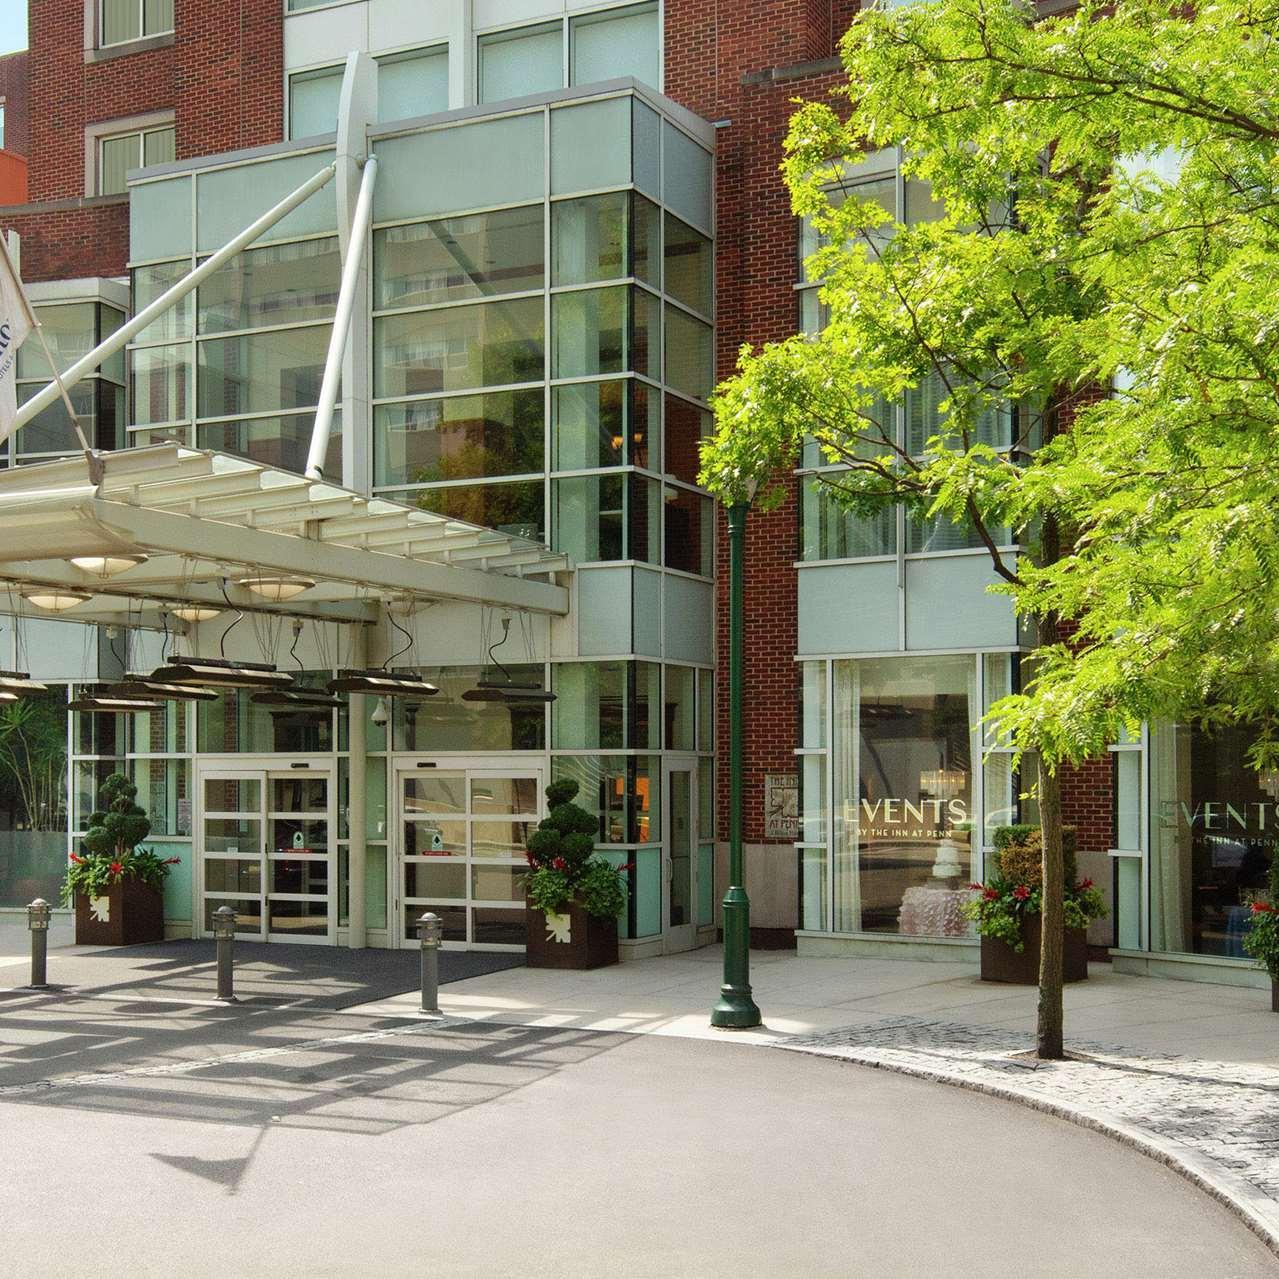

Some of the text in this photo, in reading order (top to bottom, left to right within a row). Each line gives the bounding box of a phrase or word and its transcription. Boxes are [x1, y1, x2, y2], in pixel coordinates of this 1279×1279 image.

[843, 798, 968, 825] EVENTS
[872, 829, 888, 837] THE
[891, 830, 908, 838] INN
[912, 830, 924, 838] AT
[927, 830, 952, 838] PENN
